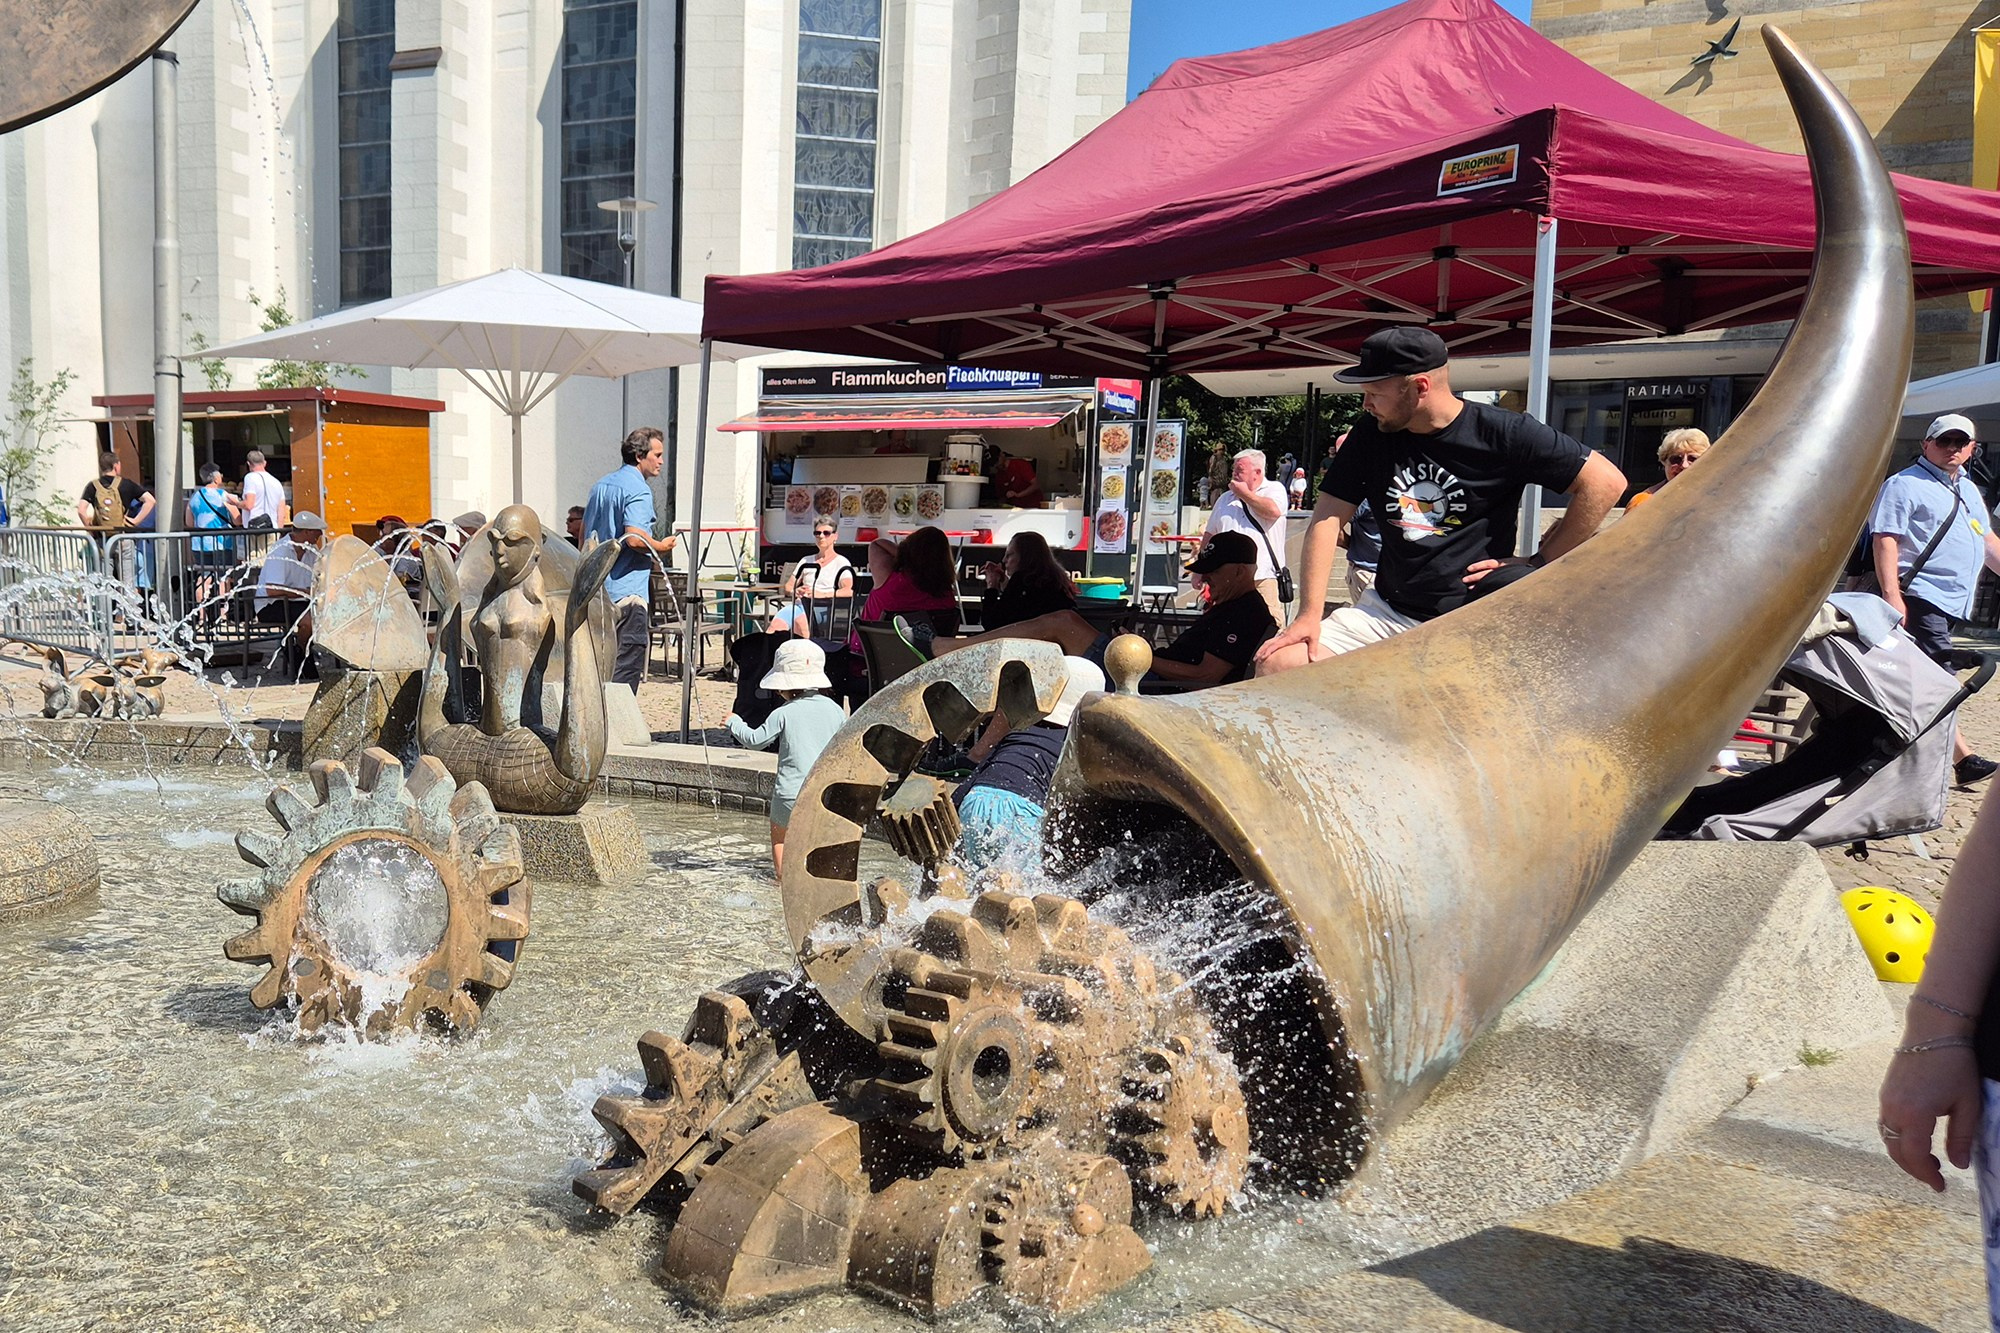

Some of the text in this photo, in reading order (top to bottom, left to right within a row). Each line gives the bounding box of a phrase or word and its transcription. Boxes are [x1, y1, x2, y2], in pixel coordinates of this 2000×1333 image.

[1450, 151, 1507, 175] EUROPRINZ
[766, 378, 781, 386] alles
[798, 377, 816, 385] frisch
[831, 370, 946, 386] Flammkuchen
[1627, 384, 1707, 397] RATHAUS
[1385, 463, 1467, 513] QUIKSILVER
